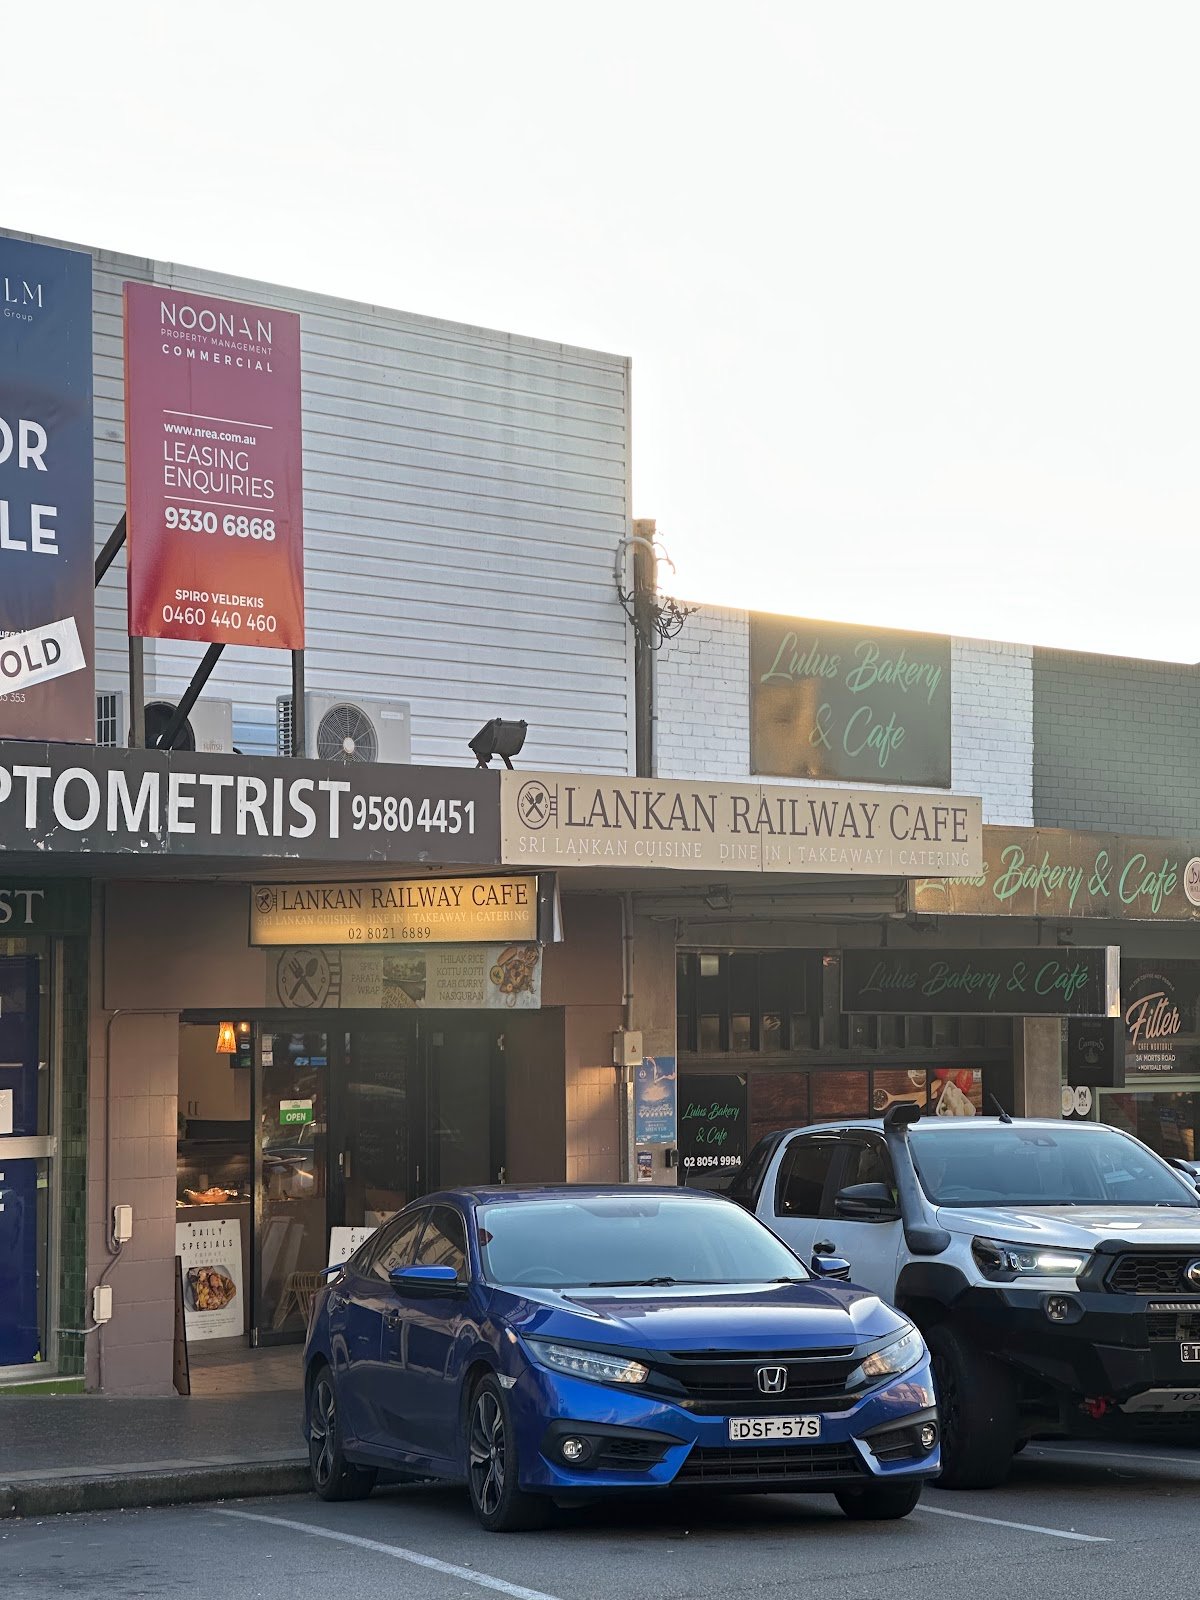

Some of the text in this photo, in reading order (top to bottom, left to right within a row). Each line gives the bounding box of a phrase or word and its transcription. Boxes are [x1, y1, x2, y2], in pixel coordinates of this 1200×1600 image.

[4, 308, 33, 322] Group
[160, 301, 272, 344] NOONAN
[161, 328, 272, 355] PROPERTY MANAGEMENT
[162, 344, 273, 372] COMMERCIAL
[164, 423, 256, 445] www.nrea.com.au
[164, 440, 249, 472] LEASING
[164, 465, 275, 499] ENQUIRIES
[164, 506, 276, 541] 9330 6868
[175, 589, 264, 608] SPIRO VELDEKIS
[162, 605, 277, 633] 0460 440 460
[760, 631, 943, 705] Lulus Bakery
[10, 693, 26, 703] 353
[808, 703, 837, 751] &
[352, 794, 413, 832] 9580
[417, 799, 476, 834] 4451
[564, 787, 969, 843] LANKAN RAILWAY CAFE
[519, 836, 970, 867] SRI LANKAN CUISINE DINE IN TAKEAWAY CATERING
[993, 845, 1084, 909] Bakery
[1088, 850, 1115, 899] &
[1119, 853, 1178, 914] Café
[281, 883, 528, 911] LANKAN RAILWAY CAFE
[275, 914, 314, 926] LANKAN
[316, 913, 358, 925] CUISINE
[413, 911, 467, 923] TAKEAWAY
[476, 909, 530, 922] CATERING
[348, 926, 431, 940] 02 8021 6889
[921, 961, 1002, 1000] Bakery
[1143, 1054, 1161, 1062] MORTS
[1162, 1054, 1175, 1062] ROAD
[286, 1112, 306, 1122] OPEN
[682, 1103, 707, 1121] Lulus
[707, 1102, 740, 1121] Bakery
[684, 1155, 741, 1167] 02 8054 9994
[182, 1239, 233, 1251] SPECIALS
[192, 1227, 223, 1237] DAILY
